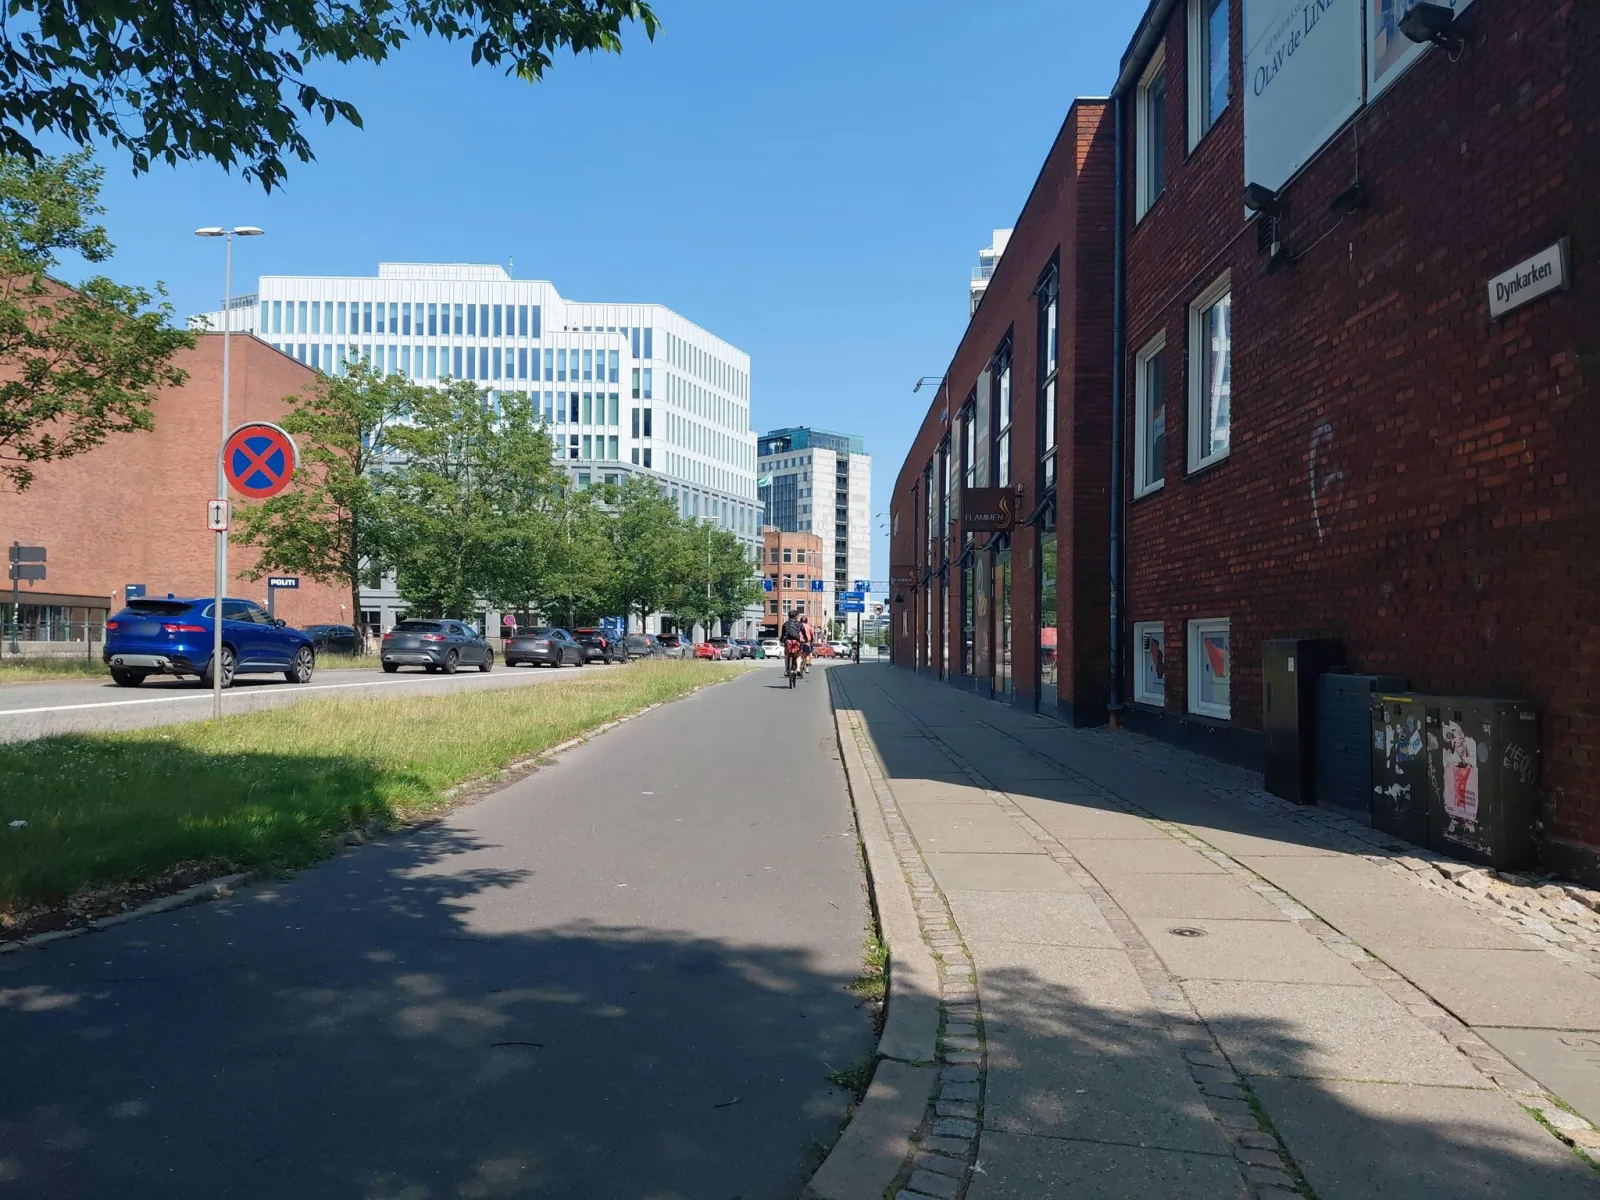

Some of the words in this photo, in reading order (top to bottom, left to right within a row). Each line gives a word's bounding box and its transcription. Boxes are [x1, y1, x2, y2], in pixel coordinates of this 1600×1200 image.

[1287, 30, 1301, 57] de
[1496, 262, 1551, 302] Dynkarken
[965, 513, 1004, 522] FLAMMEN
